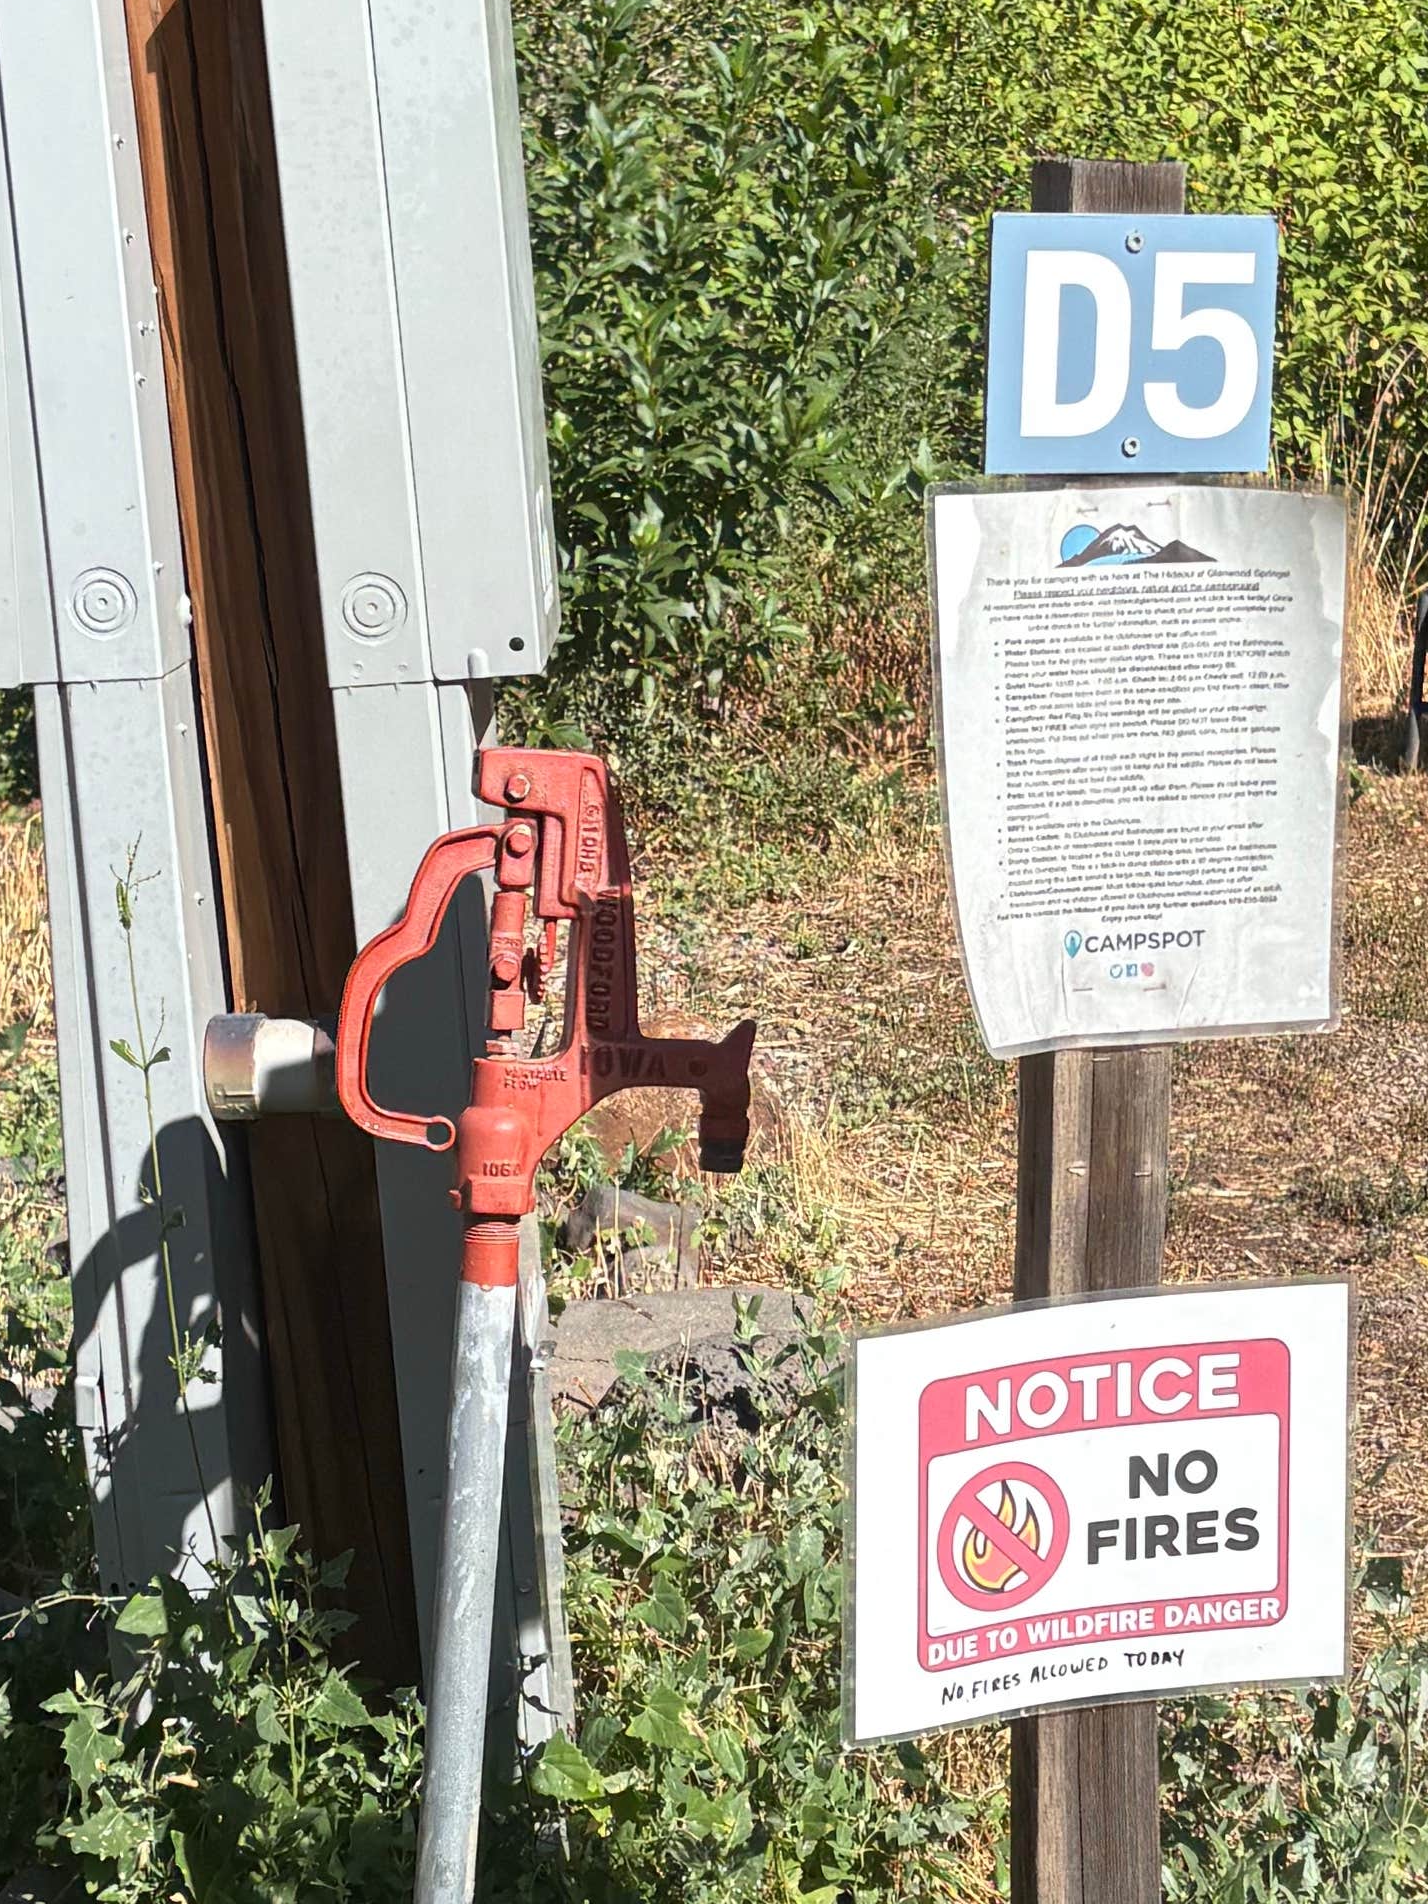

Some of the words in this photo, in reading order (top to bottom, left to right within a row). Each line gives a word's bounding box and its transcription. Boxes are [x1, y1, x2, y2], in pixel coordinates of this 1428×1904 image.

[1020, 250, 1259, 439] D5
[986, 578, 1011, 586] Thank
[1013, 578, 1029, 587] you
[1031, 576, 1041, 584] for
[1044, 576, 1078, 585] camping
[1112, 573, 1130, 581] here
[1143, 571, 1159, 579] The
[1085, 929, 1206, 953] CAMPSPOT
[1101, 915, 1122, 923] Enjoy
[1124, 914, 1141, 922] your
[587, 888, 621, 1030] WOODFORD
[580, 1045, 666, 1078] IOWA
[964, 1352, 1241, 1442] NOTICE
[1128, 1449, 1218, 1499] NO
[1087, 1507, 1260, 1565] FIRES
[928, 1635, 978, 1666] DUE
[986, 1628, 1018, 1651] TO
[1025, 1607, 1155, 1645] WILDFIRE
[1164, 1597, 1281, 1628] DANGER
[941, 1682, 963, 1705] NO
[972, 1673, 1021, 1698] FIRES
[1030, 1657, 1108, 1683] ALLOWED
[1124, 1649, 1185, 1667] TODAY
